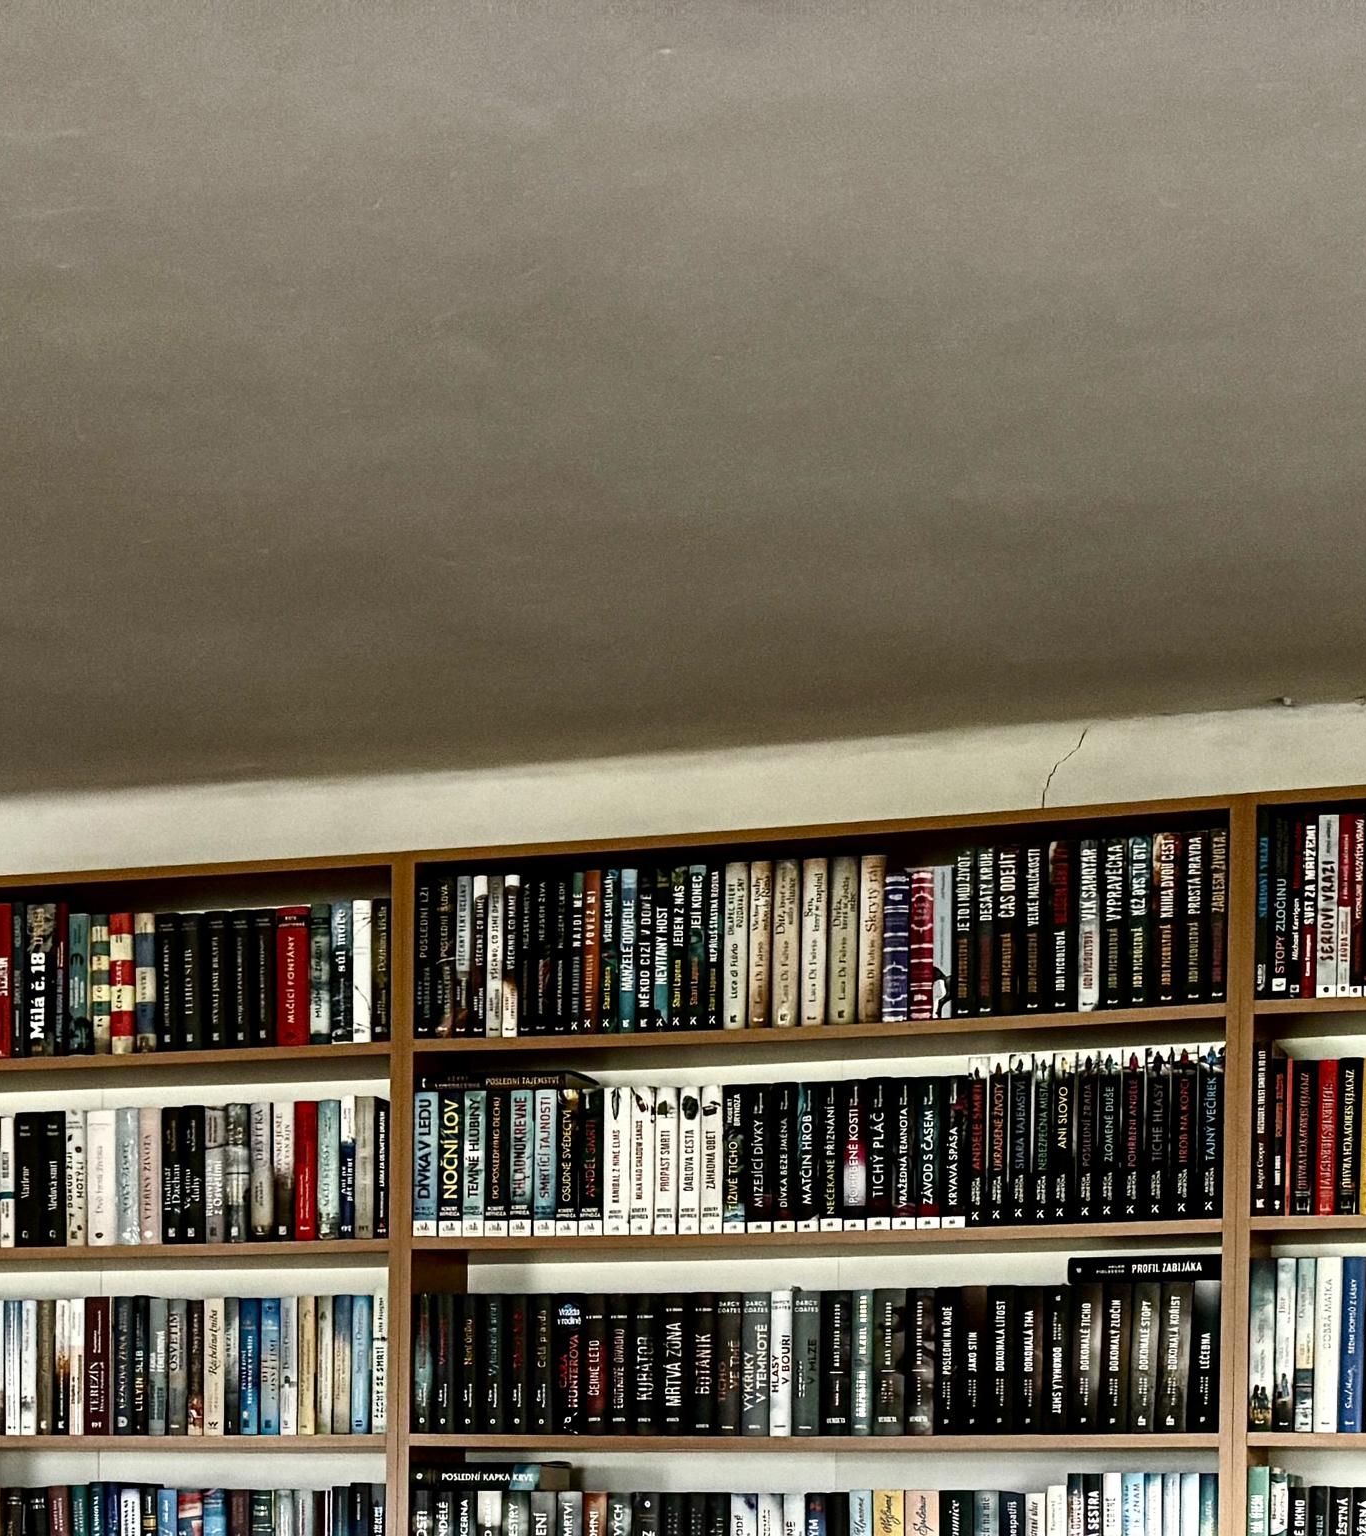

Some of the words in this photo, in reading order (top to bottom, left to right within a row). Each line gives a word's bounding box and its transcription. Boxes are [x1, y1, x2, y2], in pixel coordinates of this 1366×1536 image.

[998, 853, 1016, 891] ODEJÍT
[1188, 837, 1202, 875] PRAVDA
[673, 885, 685, 904] NÁS
[691, 875, 703, 908] KONEC
[1105, 845, 1123, 921] VYPRAVĚČKA
[1187, 877, 1201, 914] PROSTÁ
[1304, 884, 1316, 898] ZA
[1318, 860, 1335, 902] VRAZI
[621, 900, 634, 944] ODVEDLE
[690, 912, 701, 929] JEJÍ
[998, 895, 1015, 918] ČAS
[1274, 878, 1287, 932] ZLOČINU
[1292, 898, 1301, 930] Kerrigan
[673, 917, 684, 947] JEDEN
[31, 952, 45, 973] 18
[286, 936, 295, 985] FONTÁNY
[620, 944, 634, 991] MANŽELÉ
[638, 942, 651, 965] CIZÍ
[1275, 935, 1285, 973] STOPY
[31, 976, 45, 991] č.
[638, 970, 650, 1007] NĚKDO
[30, 996, 45, 1039] Milá
[419, 1099, 432, 1135] LEDU
[443, 1099, 459, 1134] LOV
[1058, 1087, 1068, 1124] SLOVO
[1203, 1077, 1216, 1122] VEČÍREK
[467, 1099, 481, 1152] HLUBINY
[539, 1096, 552, 1149] TAJNOSTI
[561, 1109, 572, 1159] SVĚDECTVÍ
[751, 1120, 763, 1154] DÍVKY
[779, 1118, 788, 1151] JMÉNA
[801, 1115, 812, 1150] HROB
[824, 1106, 835, 1156] PŘIZNÁNÍ
[869, 1112, 884, 1148] PLÁČ
[899, 1108, 908, 1154] TEMNOTA
[920, 1110, 934, 1151] ČASEM
[1057, 1128, 1067, 1149] ANI
[419, 1140, 431, 1151] V
[728, 1141, 738, 1175] TICHO
[946, 1127, 958, 1160] SPÁSA
[1204, 1126, 1215, 1161] TAJNÝ
[415, 1152, 431, 1199] DÍVKA
[440, 1140, 458, 1199] NOČNÍ
[465, 1155, 480, 1198] TEMNÉ
[537, 1153, 551, 1198] SMRTÍCÍ
[561, 1162, 571, 1202] OSUDNÉ
[751, 1158, 763, 1207] MIZEJÍCÍ
[780, 1154, 788, 1175] BEZE
[799, 1154, 813, 1204] MATČIN
[870, 1152, 884, 1198] TICHÝ
[897, 1156, 908, 1208] VRAŽEDNÁ
[726, 1178, 738, 1210] TÍŽIVÉ
[778, 1178, 788, 1207] DÍVKA
[824, 1159, 835, 1214] NEČEKANÉ
[921, 1163, 933, 1205] ZÁVOD
[946, 1163, 958, 1205] KRVAVÁ
[1131, 1262, 1160, 1274] PROFIL
[1162, 1261, 1203, 1273] ZABIJÁKA
[995, 1301, 1005, 1327] LÍTOST
[666, 1322, 682, 1357] ZÓNA
[756, 1325, 767, 1389] TEMNOTĚ
[781, 1335, 791, 1372] BOUŘI
[995, 1329, 1005, 1371] DOKONALÁ
[1199, 1333, 1211, 1369] LÉČEBNA
[88, 1362, 99, 1413] TEREZÍN
[663, 1362, 682, 1406] MRTVÁ
[743, 1352, 754, 1411] VÝKŘIKY
[771, 1354, 779, 1393] HLASY
[782, 1377, 790, 1385] V
[756, 1393, 766, 1403] V
[442, 1472, 482, 1480] POSLEDNÍ
[513, 1473, 533, 1481] KRVE
